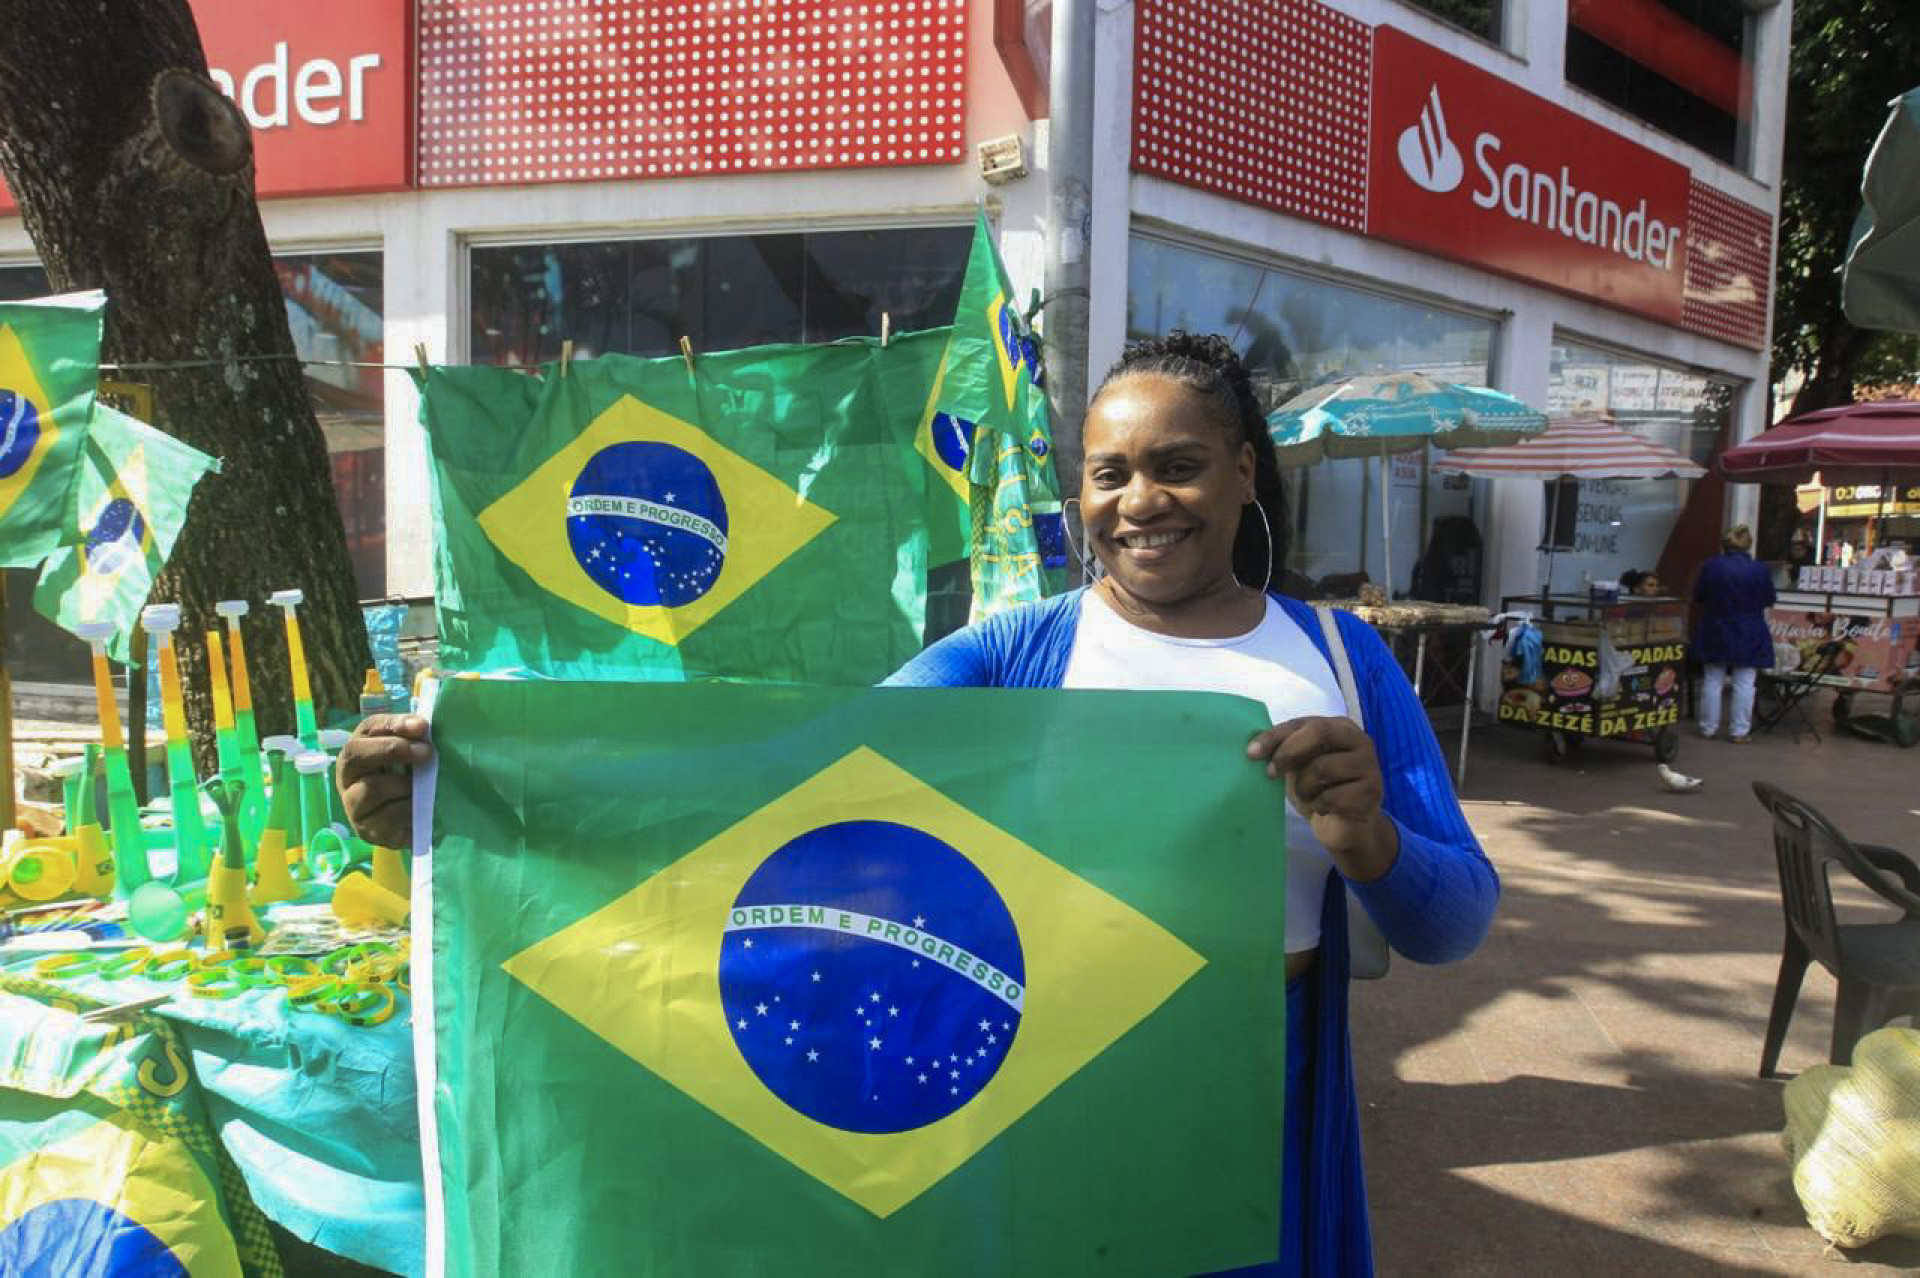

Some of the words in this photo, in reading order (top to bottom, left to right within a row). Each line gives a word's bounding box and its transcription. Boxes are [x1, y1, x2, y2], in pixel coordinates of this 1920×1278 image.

[1472, 131, 1681, 270] Santander
[572, 499, 623, 513] ORDEM
[626, 501, 636, 514] E
[639, 503, 725, 546] PROGRESSO
[1631, 645, 1684, 664] PADAS
[1499, 704, 1529, 721] DA
[1600, 717, 1627, 736] DA
[733, 906, 826, 928] ORDEM
[839, 914, 852, 929] E
[866, 918, 1021, 1001] PROGRESSO
